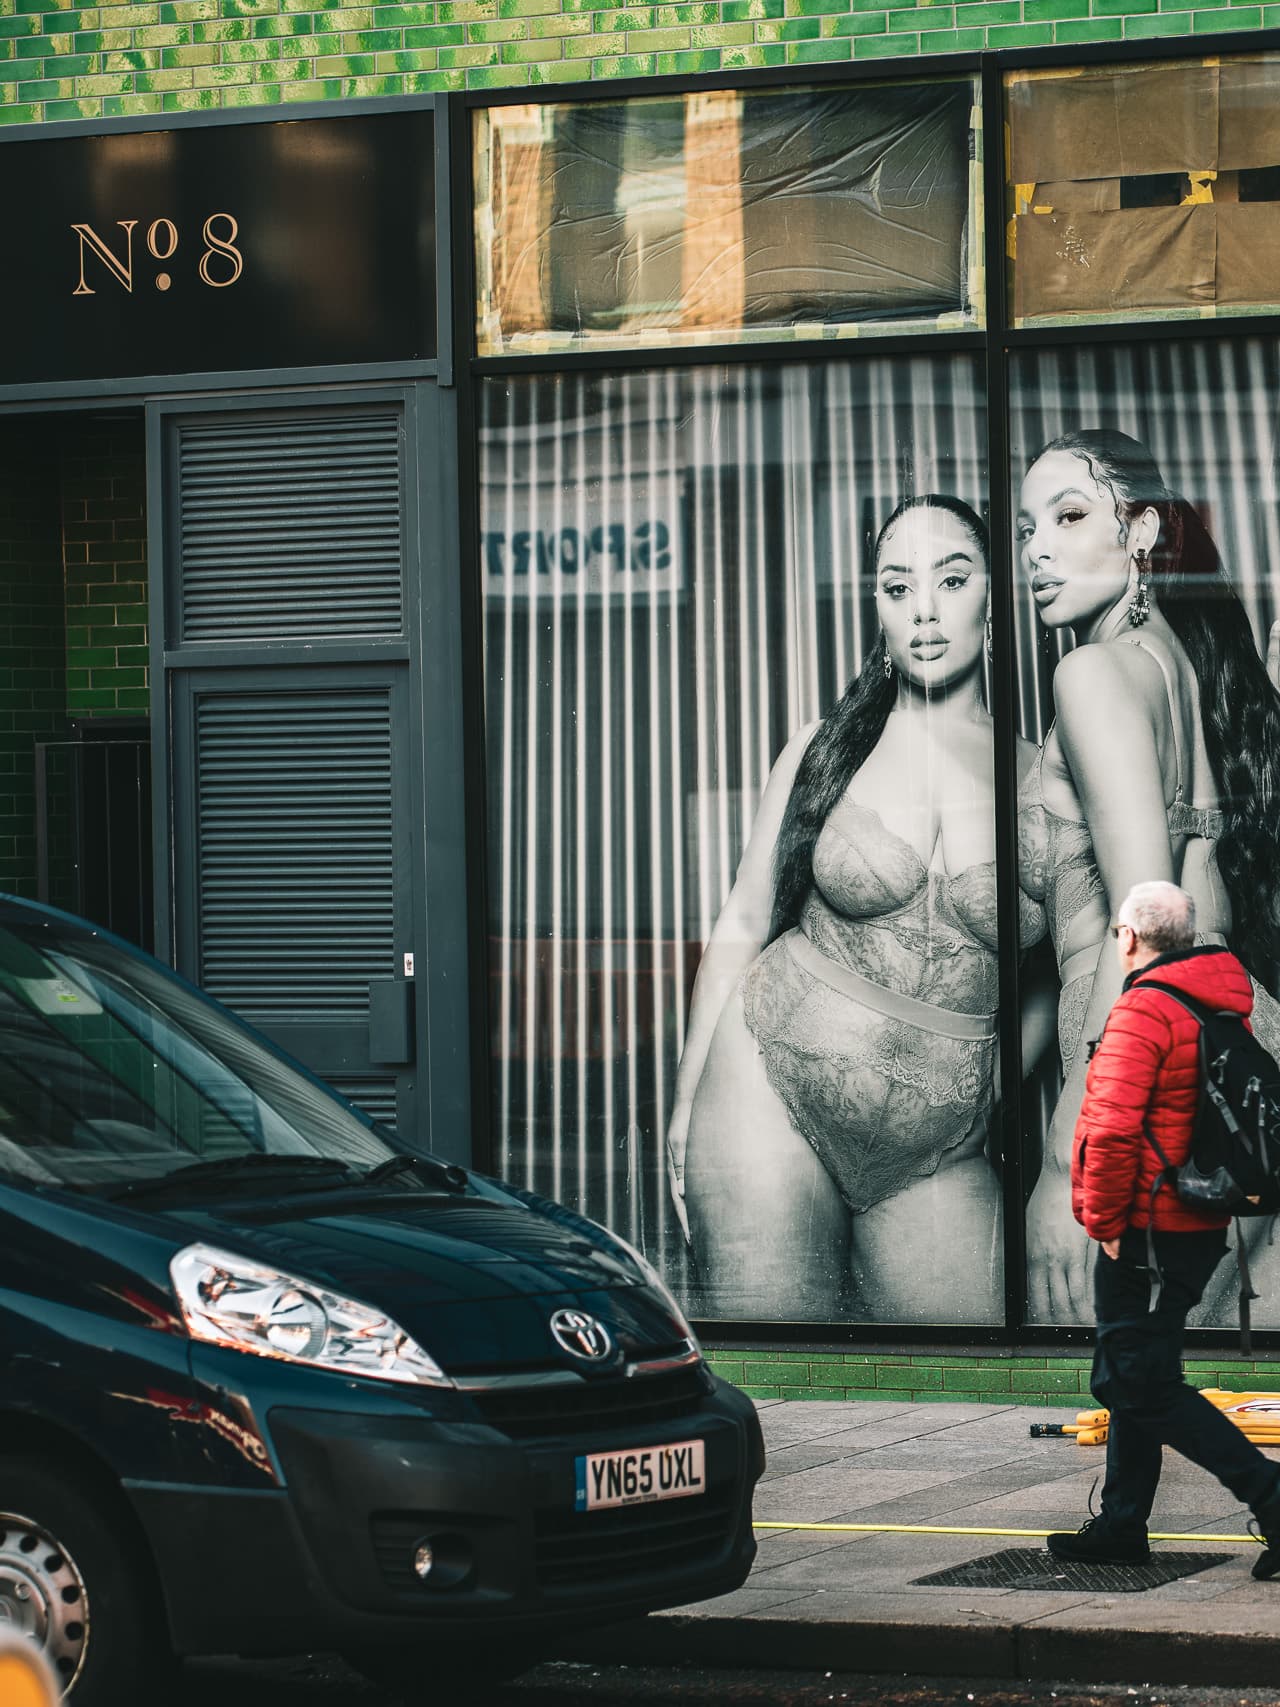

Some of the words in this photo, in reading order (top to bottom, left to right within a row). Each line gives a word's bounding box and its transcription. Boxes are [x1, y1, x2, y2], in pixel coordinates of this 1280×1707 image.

[199, 212, 243, 287] 8
[591, 1453, 653, 1500] YN65
[659, 1447, 701, 1490] UXL
